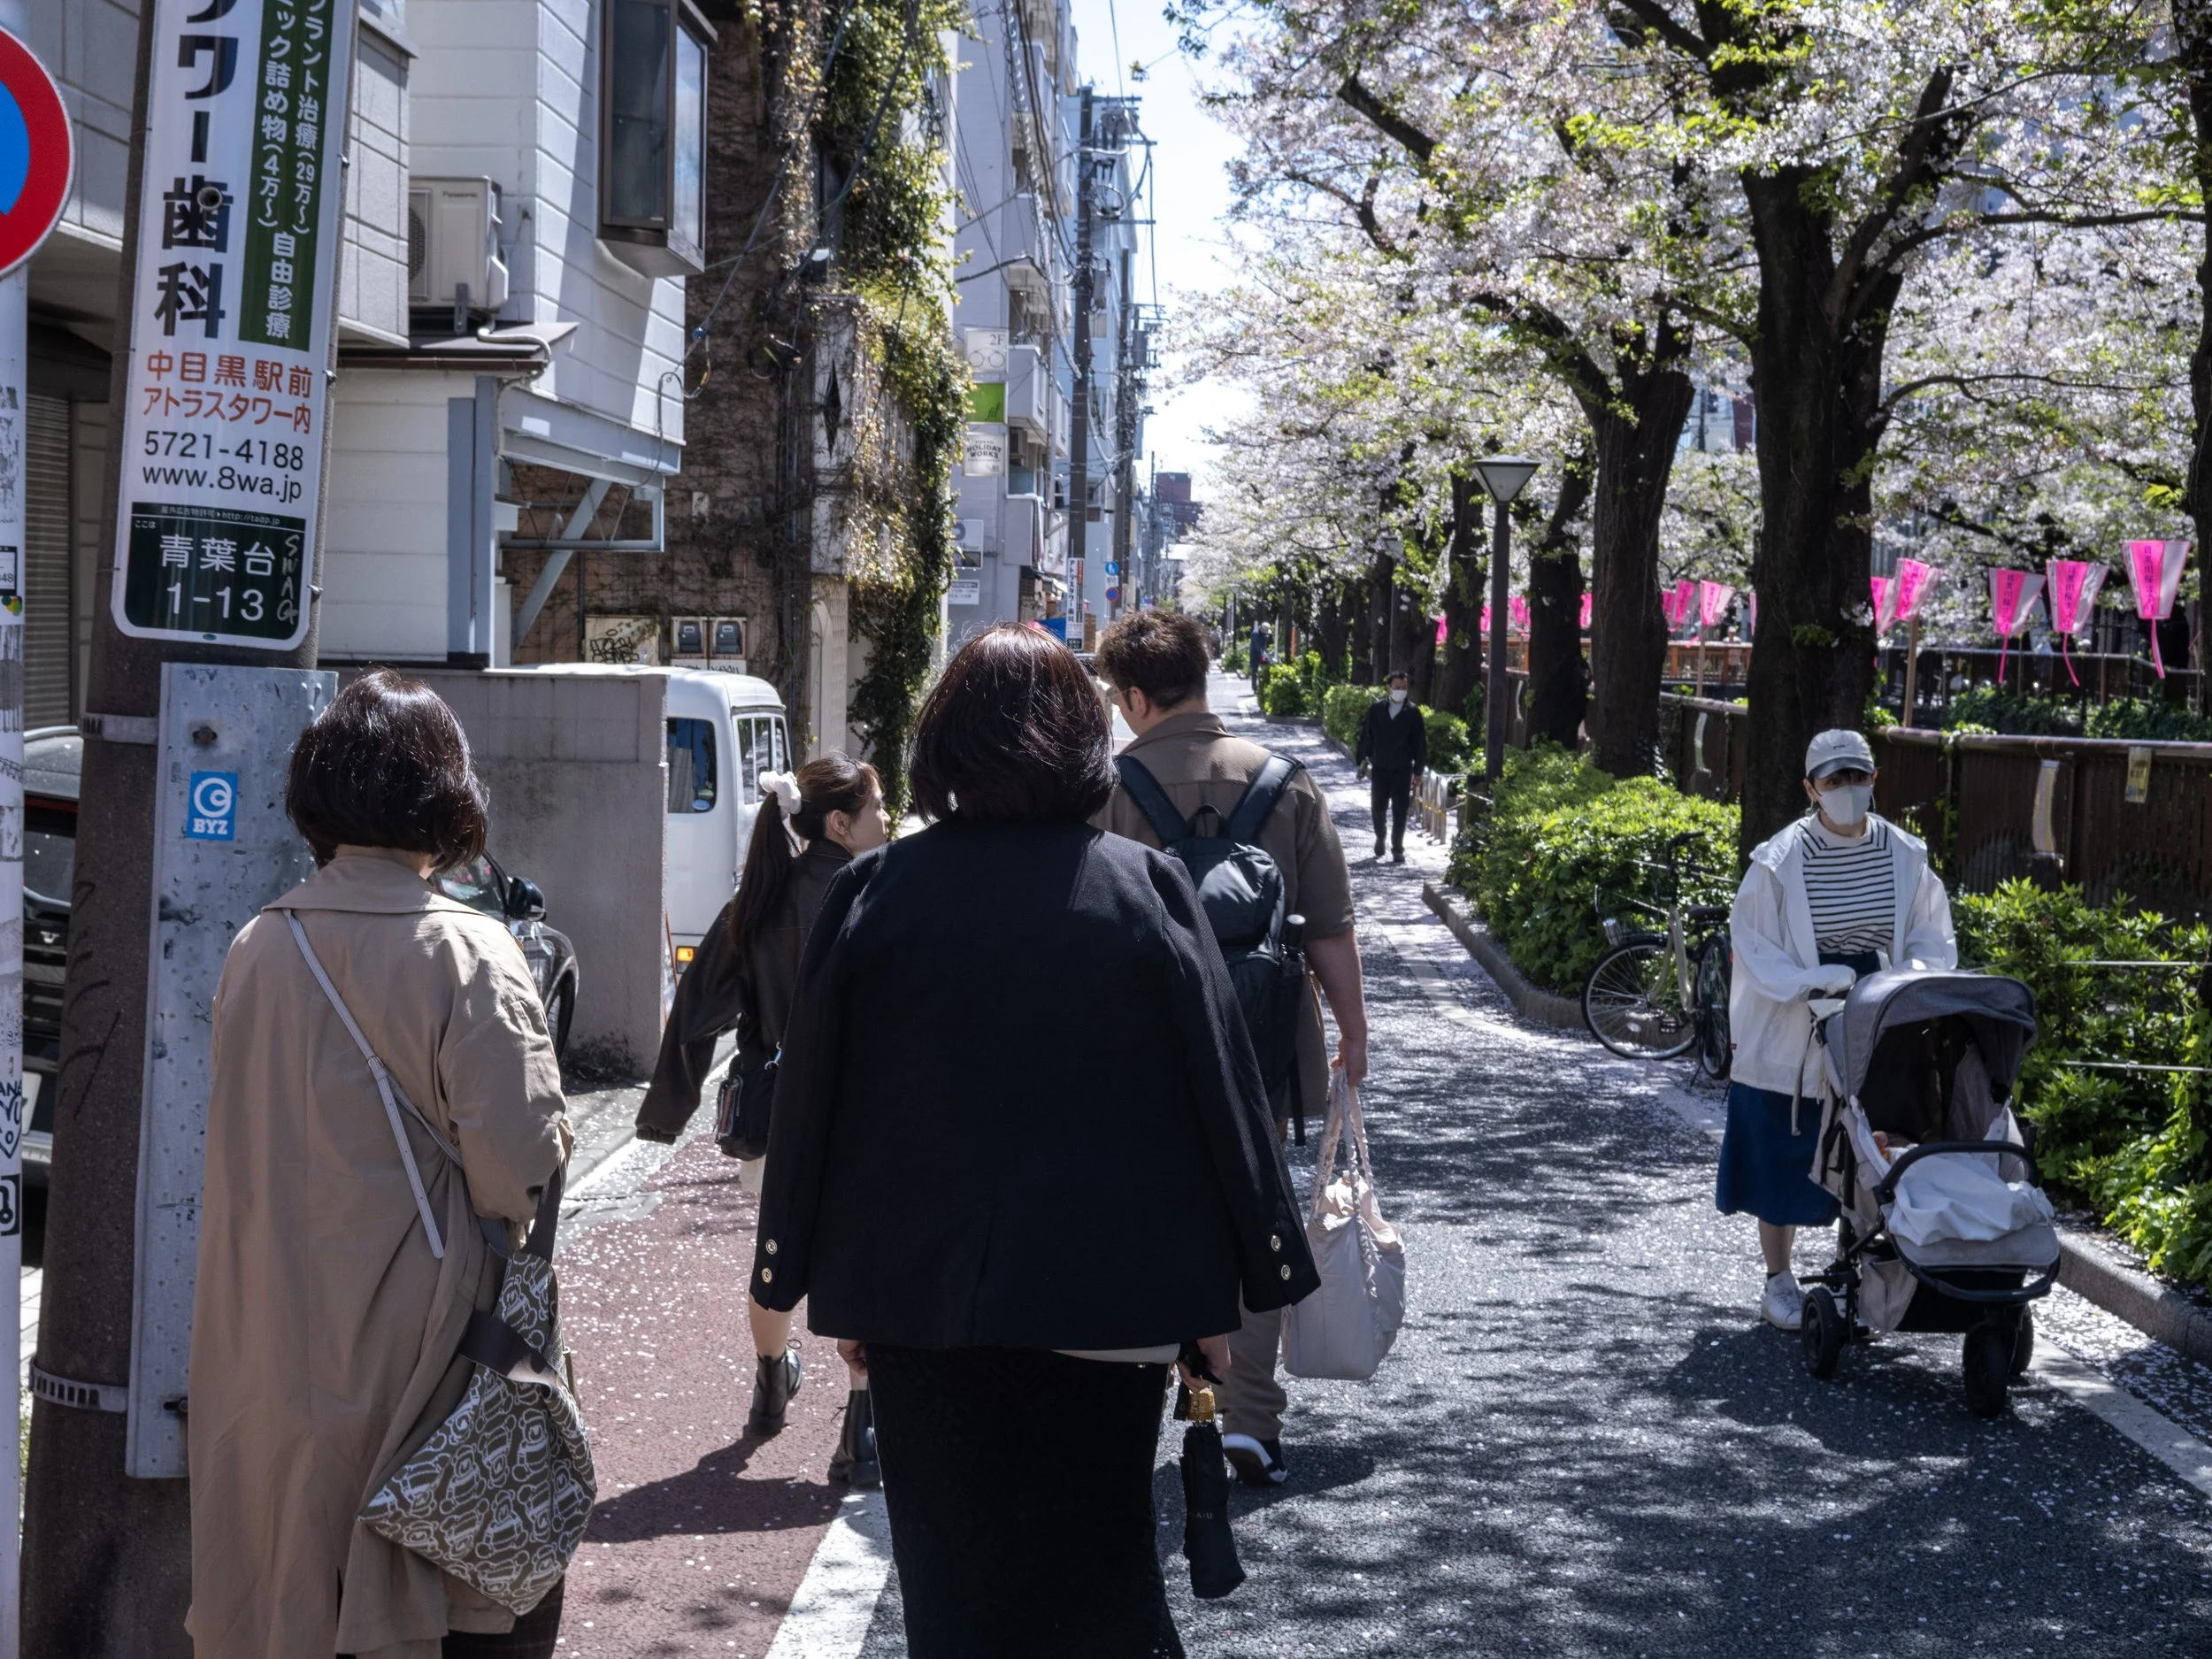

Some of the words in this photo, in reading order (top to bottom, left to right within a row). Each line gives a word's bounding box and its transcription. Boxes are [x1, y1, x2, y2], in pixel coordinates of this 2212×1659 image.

[265, 231, 296, 339] 自由診療
[990, 334, 1005, 346] 2F
[147, 349, 312, 398] 中目黒駅前
[143, 387, 311, 434] アトラスタワー内
[144, 430, 303, 471] 5721-4188
[966, 444, 1002, 453] HOLIDAY
[142, 466, 302, 503] www.8wa.jp
[134, 520, 157, 529] ここは
[159, 534, 276, 577] 青葉台
[166, 582, 264, 621] 1-13
[193, 818, 228, 835] BYZ
